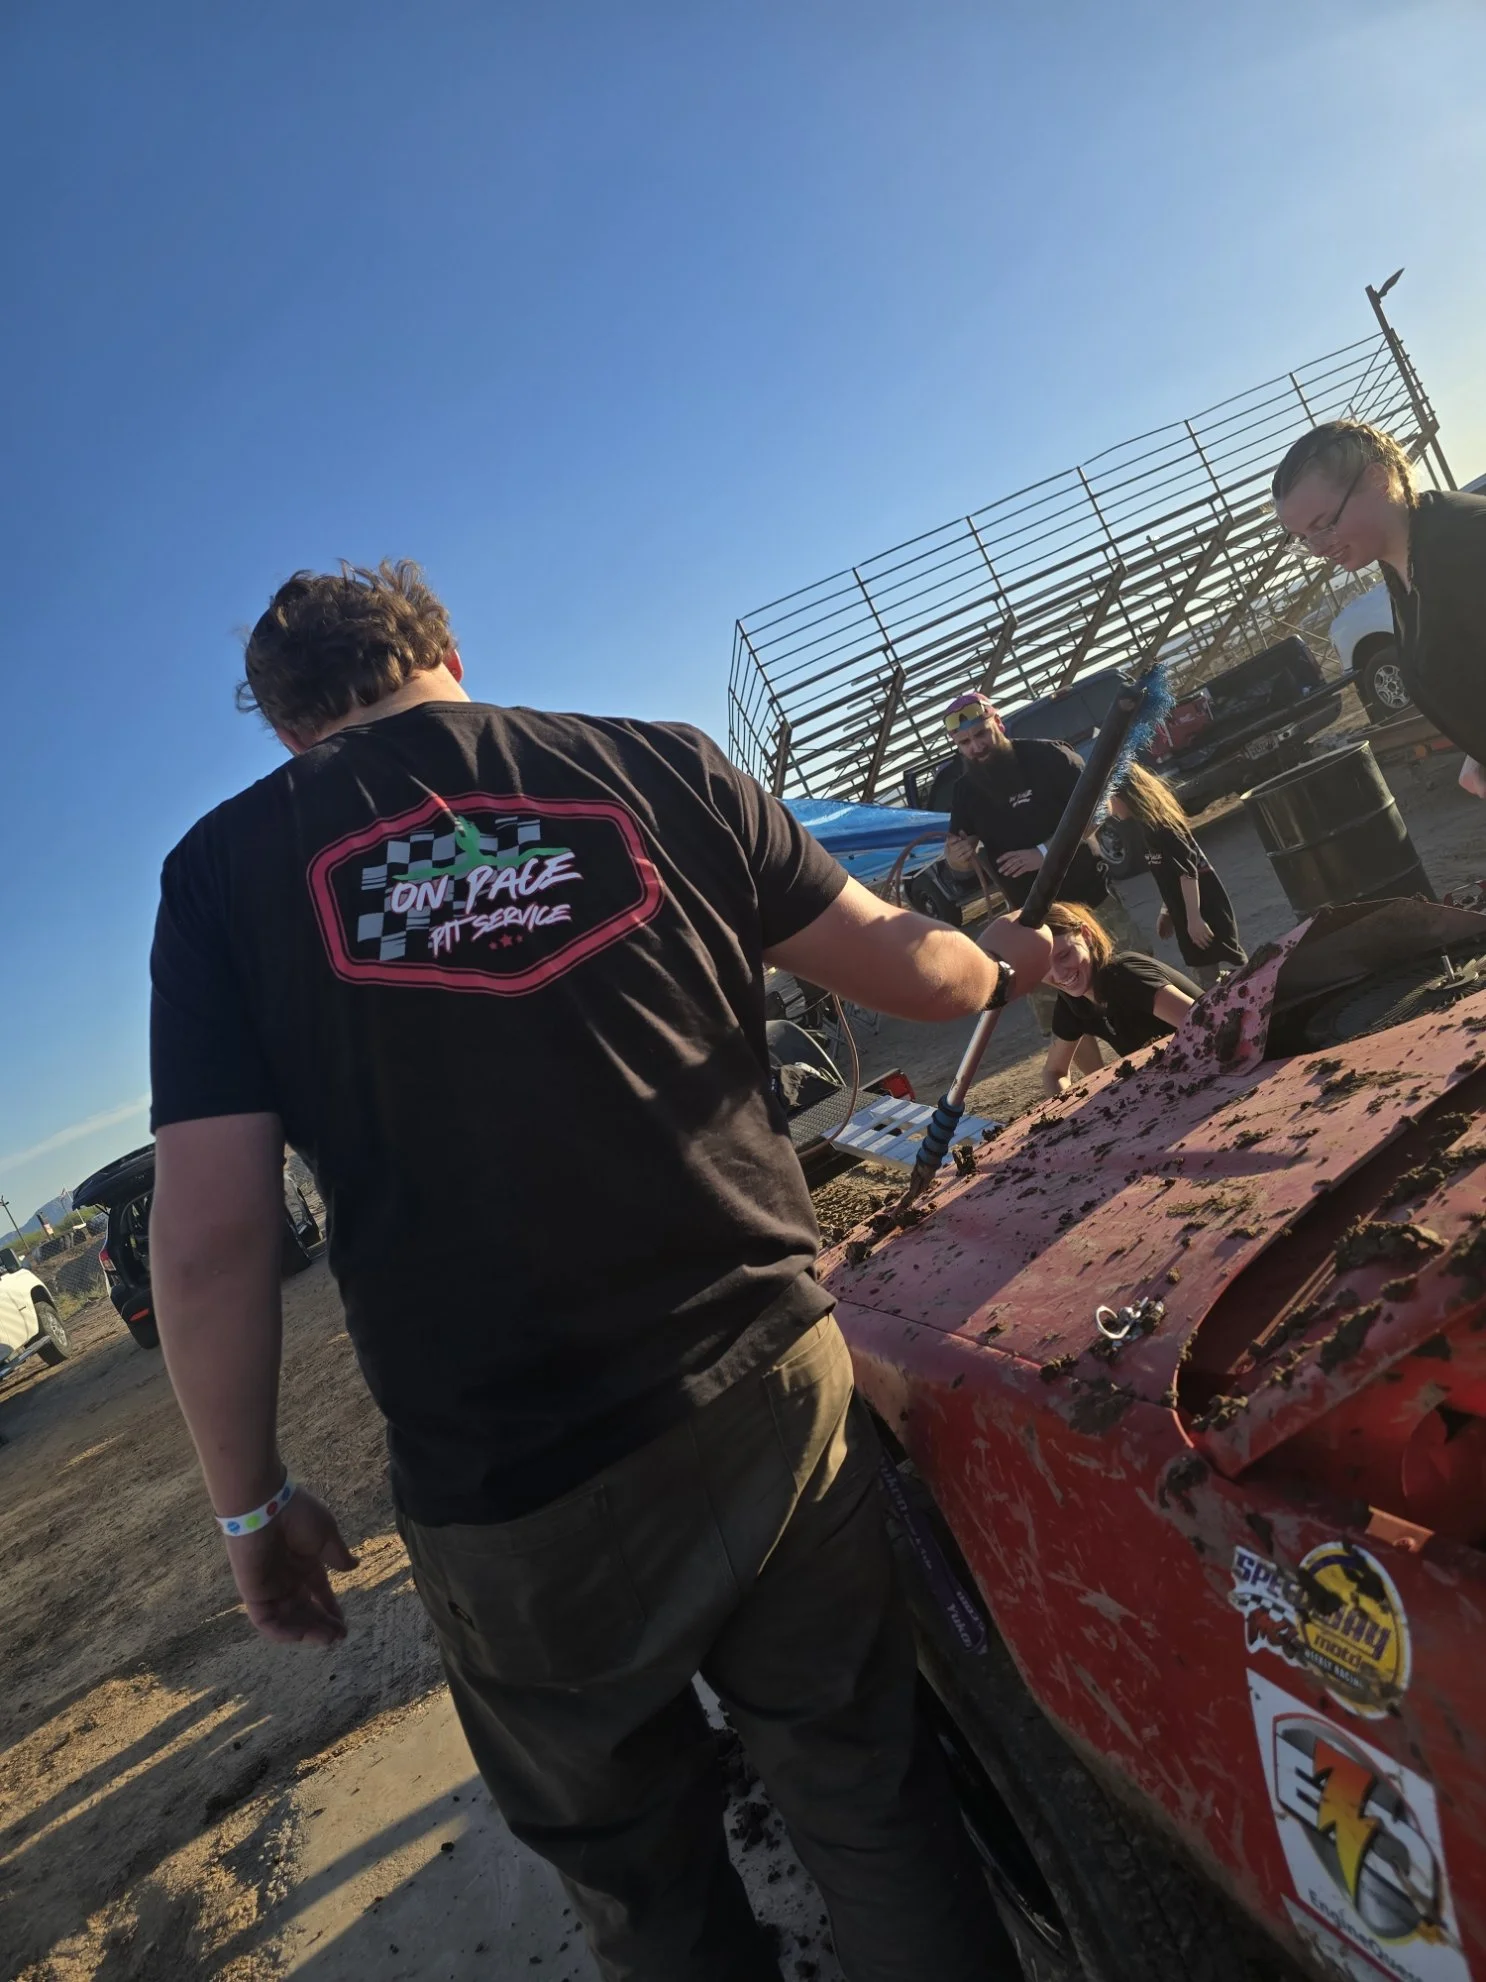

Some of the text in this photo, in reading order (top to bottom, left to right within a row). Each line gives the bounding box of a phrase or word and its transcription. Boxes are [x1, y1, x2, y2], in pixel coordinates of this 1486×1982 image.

[390, 851, 585, 914] ON PACE
[471, 904, 572, 941] SERVICE
